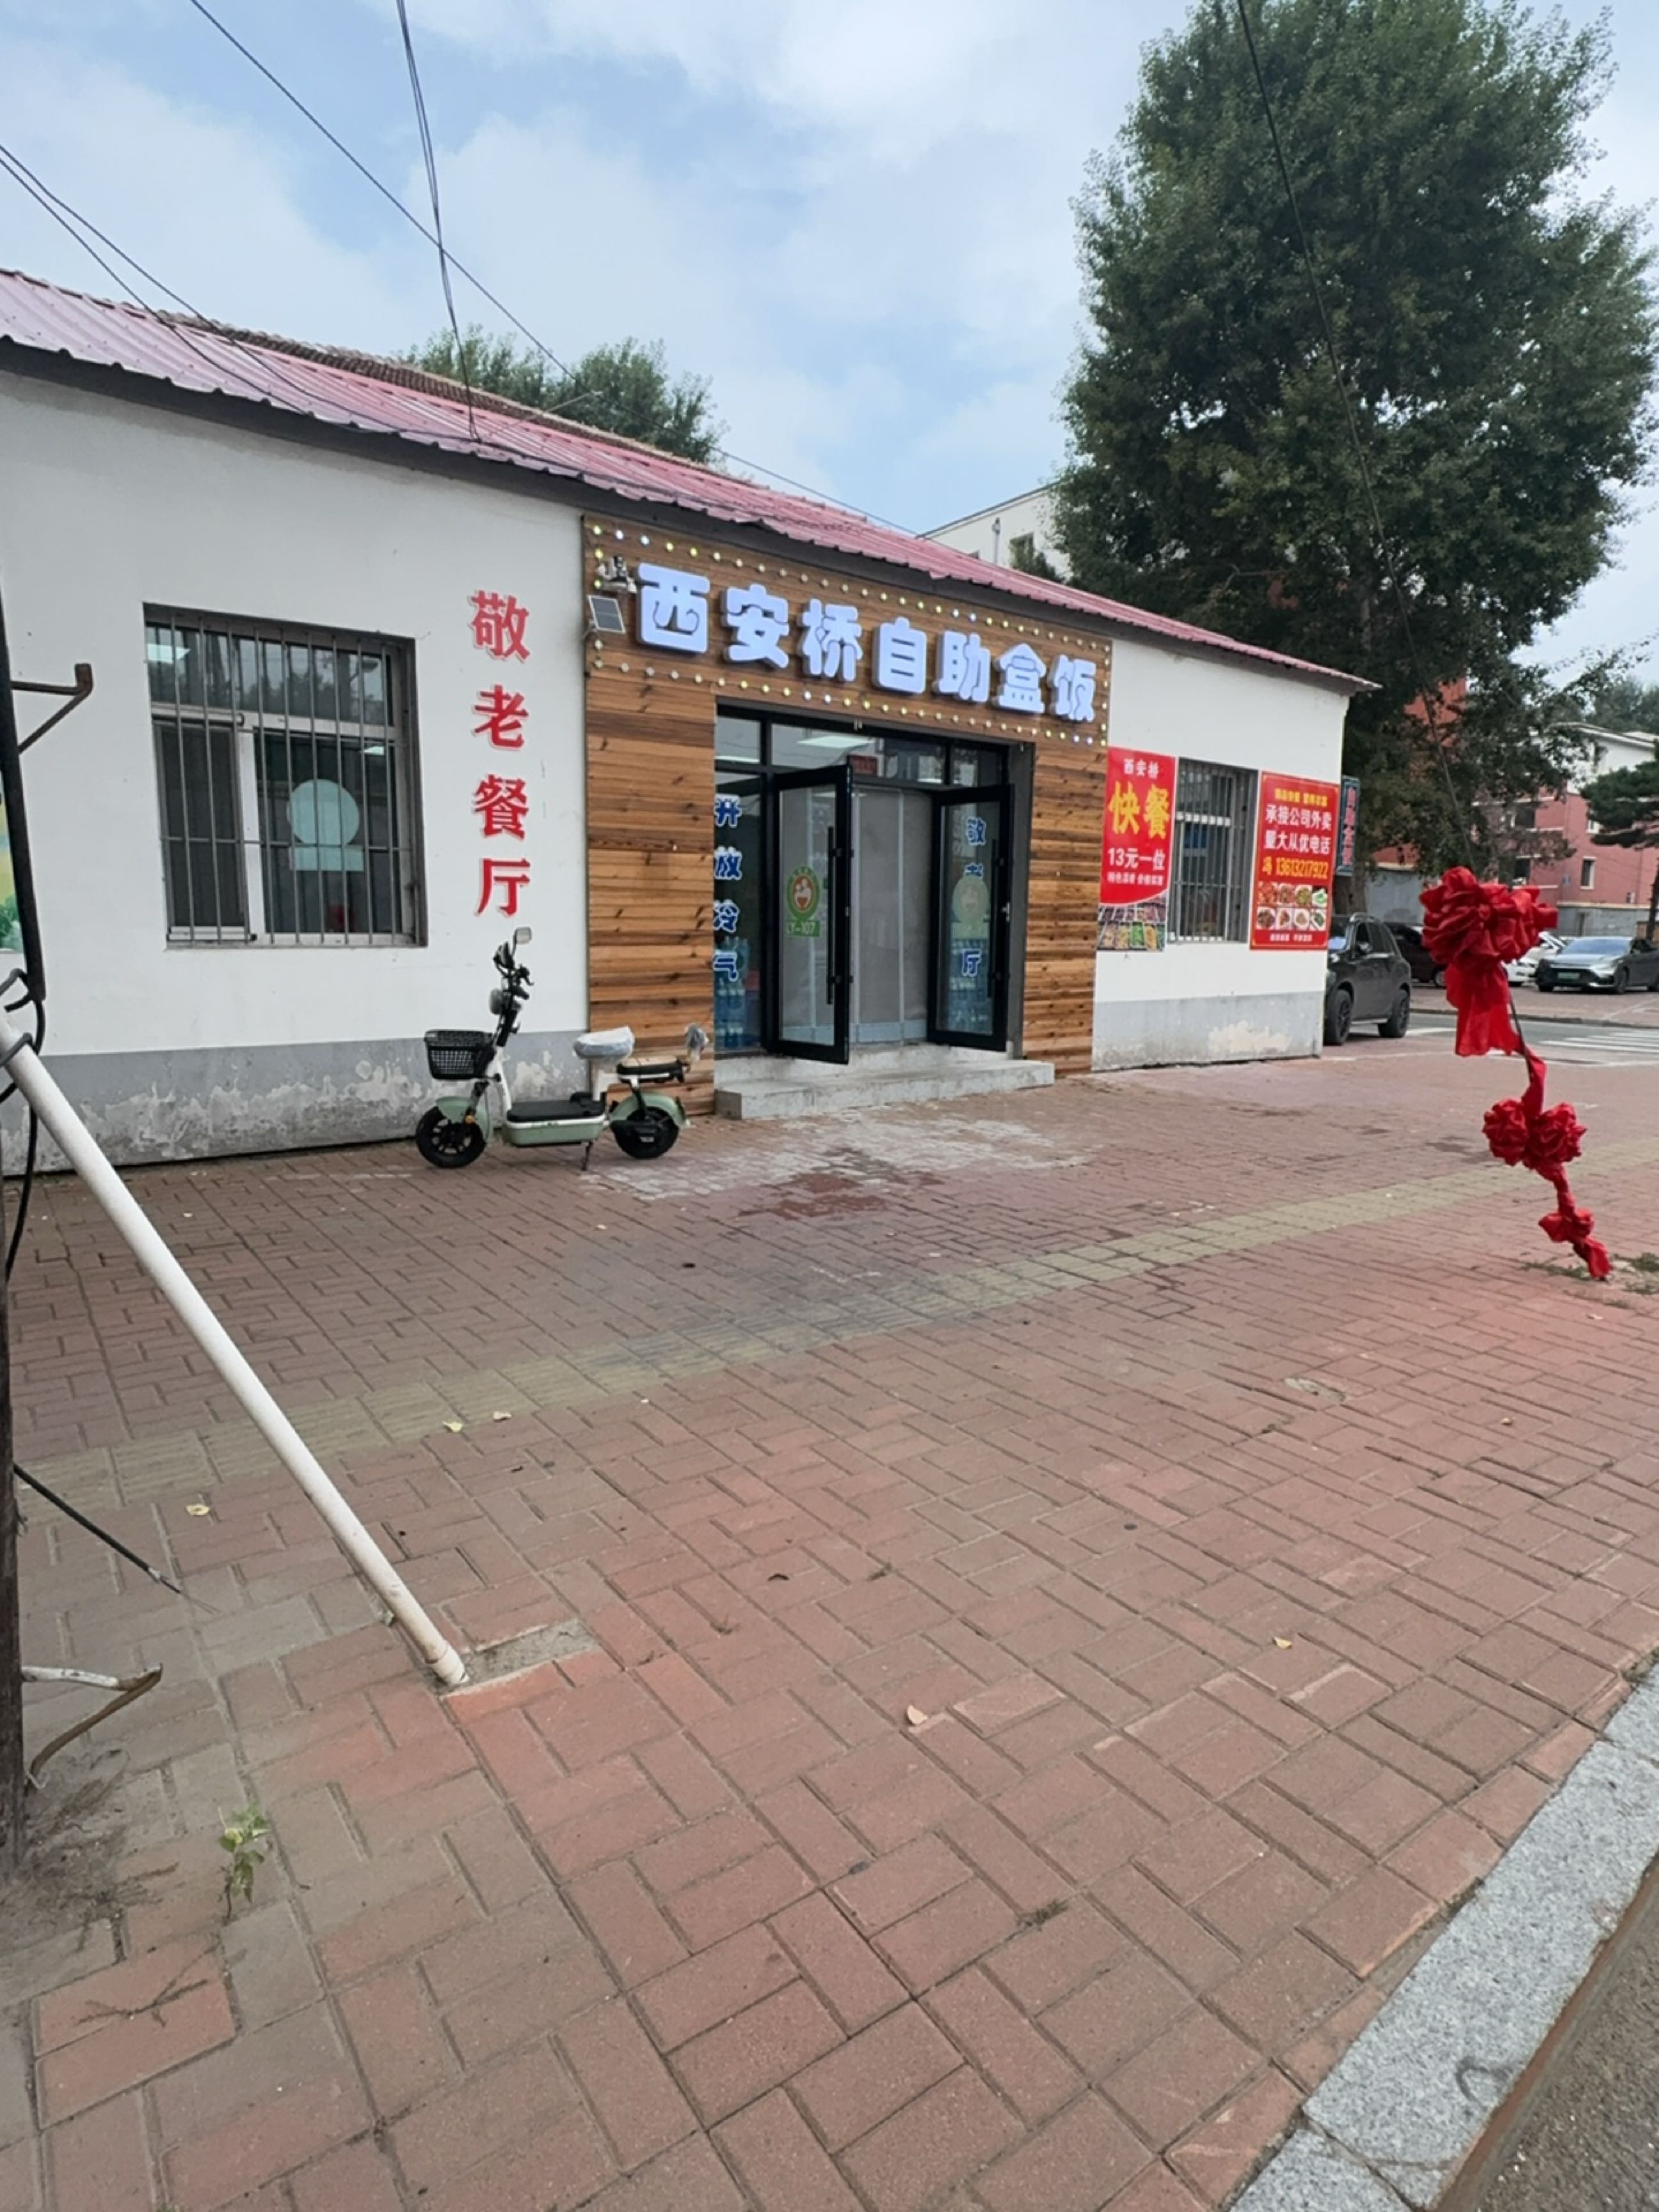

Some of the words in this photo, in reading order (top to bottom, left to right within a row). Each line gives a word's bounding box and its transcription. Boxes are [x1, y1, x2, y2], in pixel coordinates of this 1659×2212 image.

[636, 561, 1097, 723] 西安桥自助盒饭
[469, 589, 531, 918] 敬老餐厅
[1108, 780, 1169, 839] 快餐
[1265, 804, 1332, 831] 承接公司外卖
[1107, 847, 1166, 870] 13元一位
[1263, 830, 1331, 854] 量大从优电话
